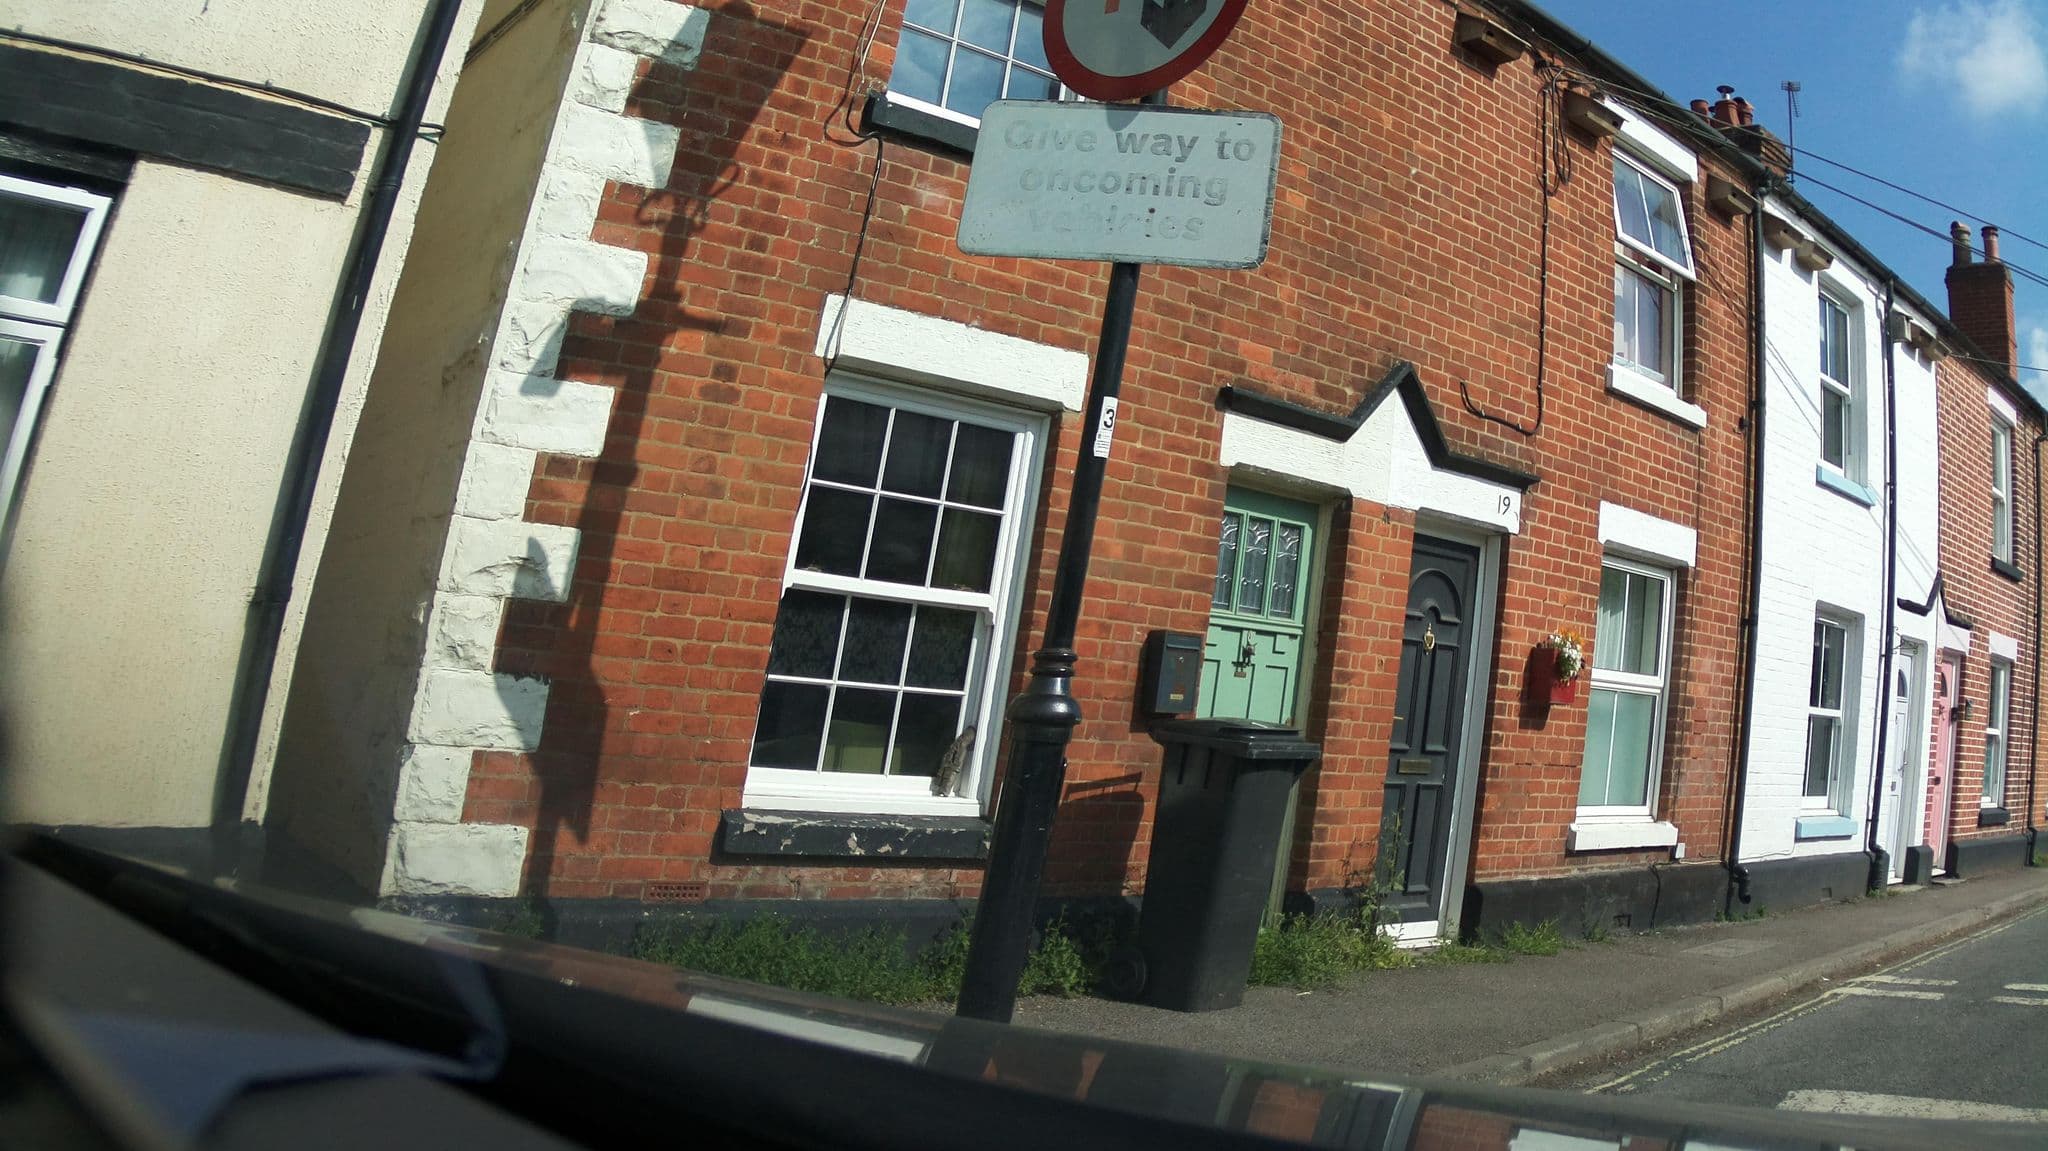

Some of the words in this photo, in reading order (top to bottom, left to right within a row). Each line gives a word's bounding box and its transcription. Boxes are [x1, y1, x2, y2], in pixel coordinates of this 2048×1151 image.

[1004, 119, 1097, 153] Give
[1115, 131, 1199, 163] way
[1214, 130, 1257, 162] to
[1019, 167, 1229, 207] oncoming
[1103, 408, 1115, 429] 3
[1497, 494, 1511, 516] 19
